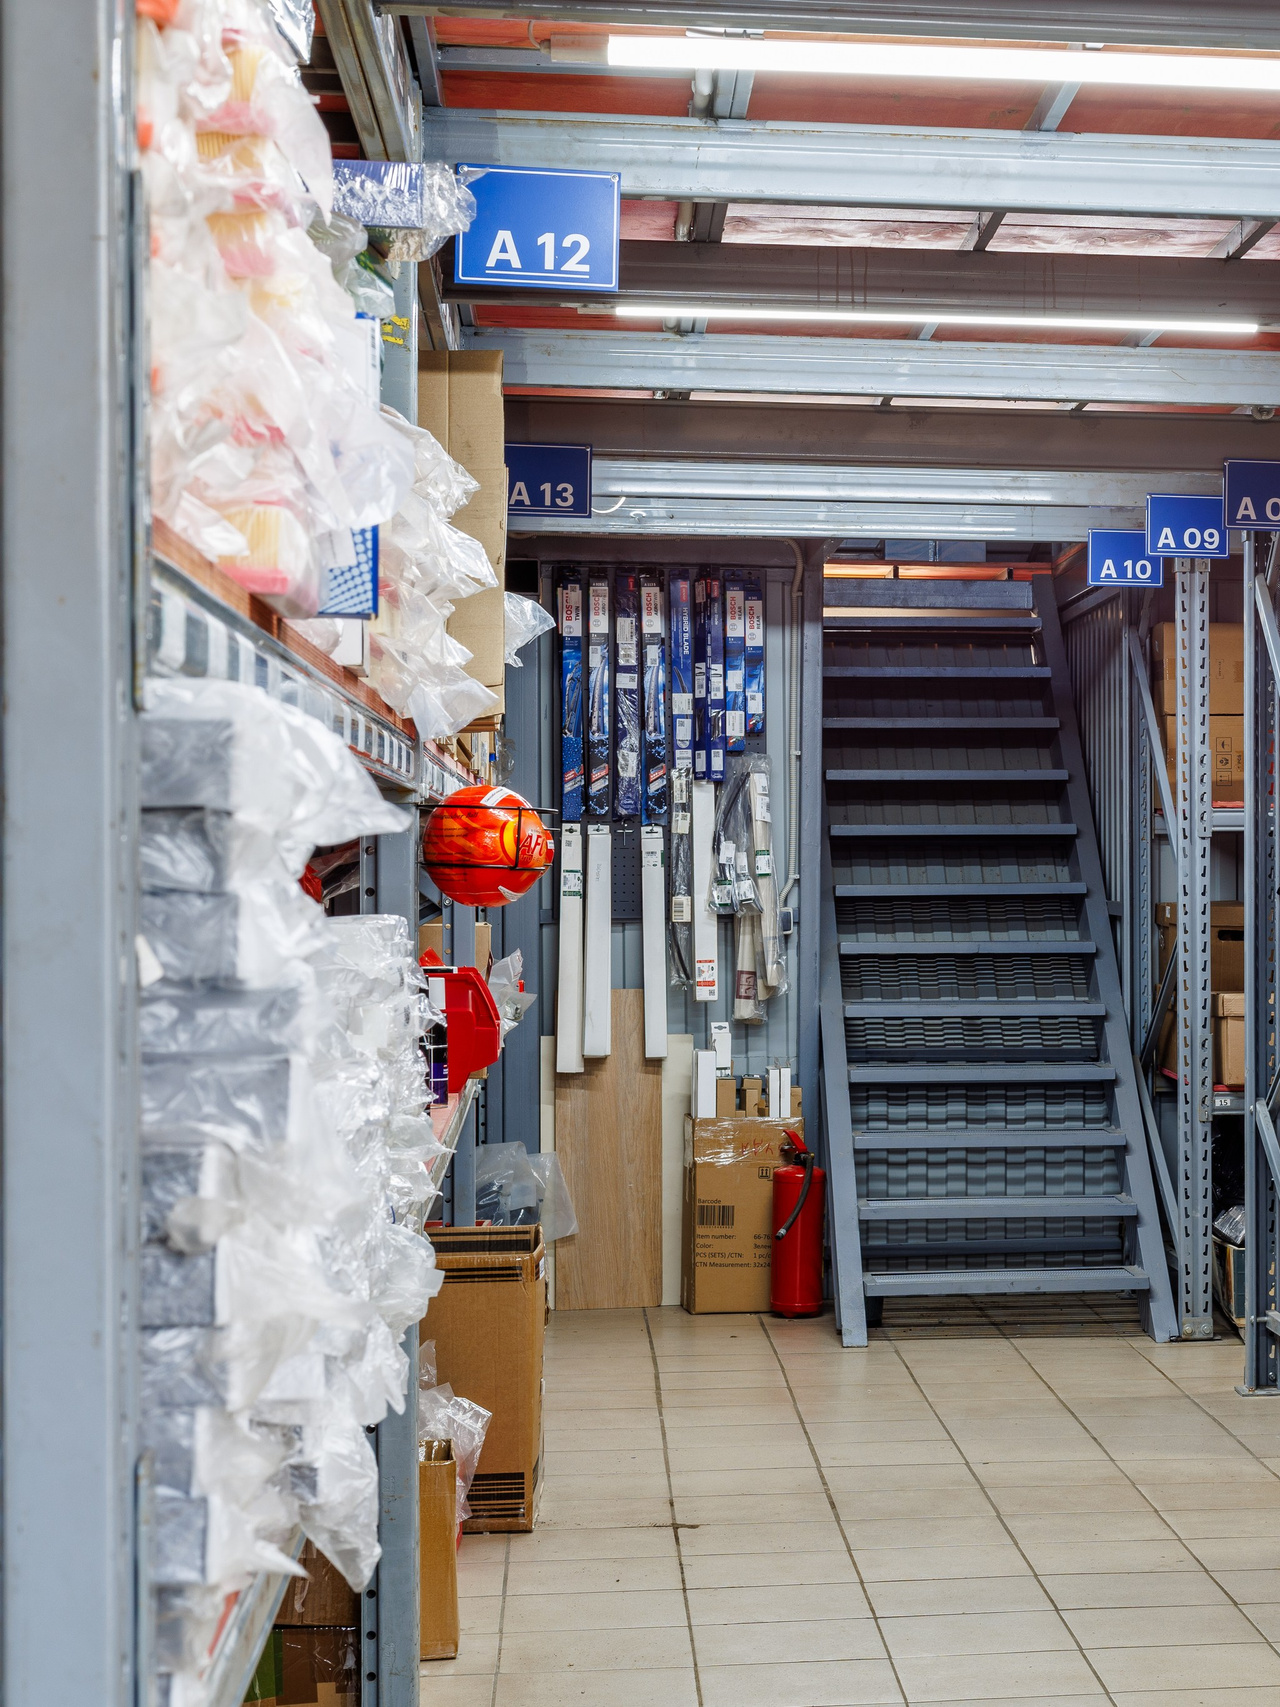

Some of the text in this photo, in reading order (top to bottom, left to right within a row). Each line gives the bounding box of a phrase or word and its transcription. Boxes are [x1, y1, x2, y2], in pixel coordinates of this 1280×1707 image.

[486, 230, 591, 273] A 12
[510, 482, 574, 506] A 13
[1237, 497, 1257, 520] A
[1157, 527, 1220, 549] A 09
[1100, 559, 1152, 579] A 10
[1219, 1099, 1228, 1107] 15
